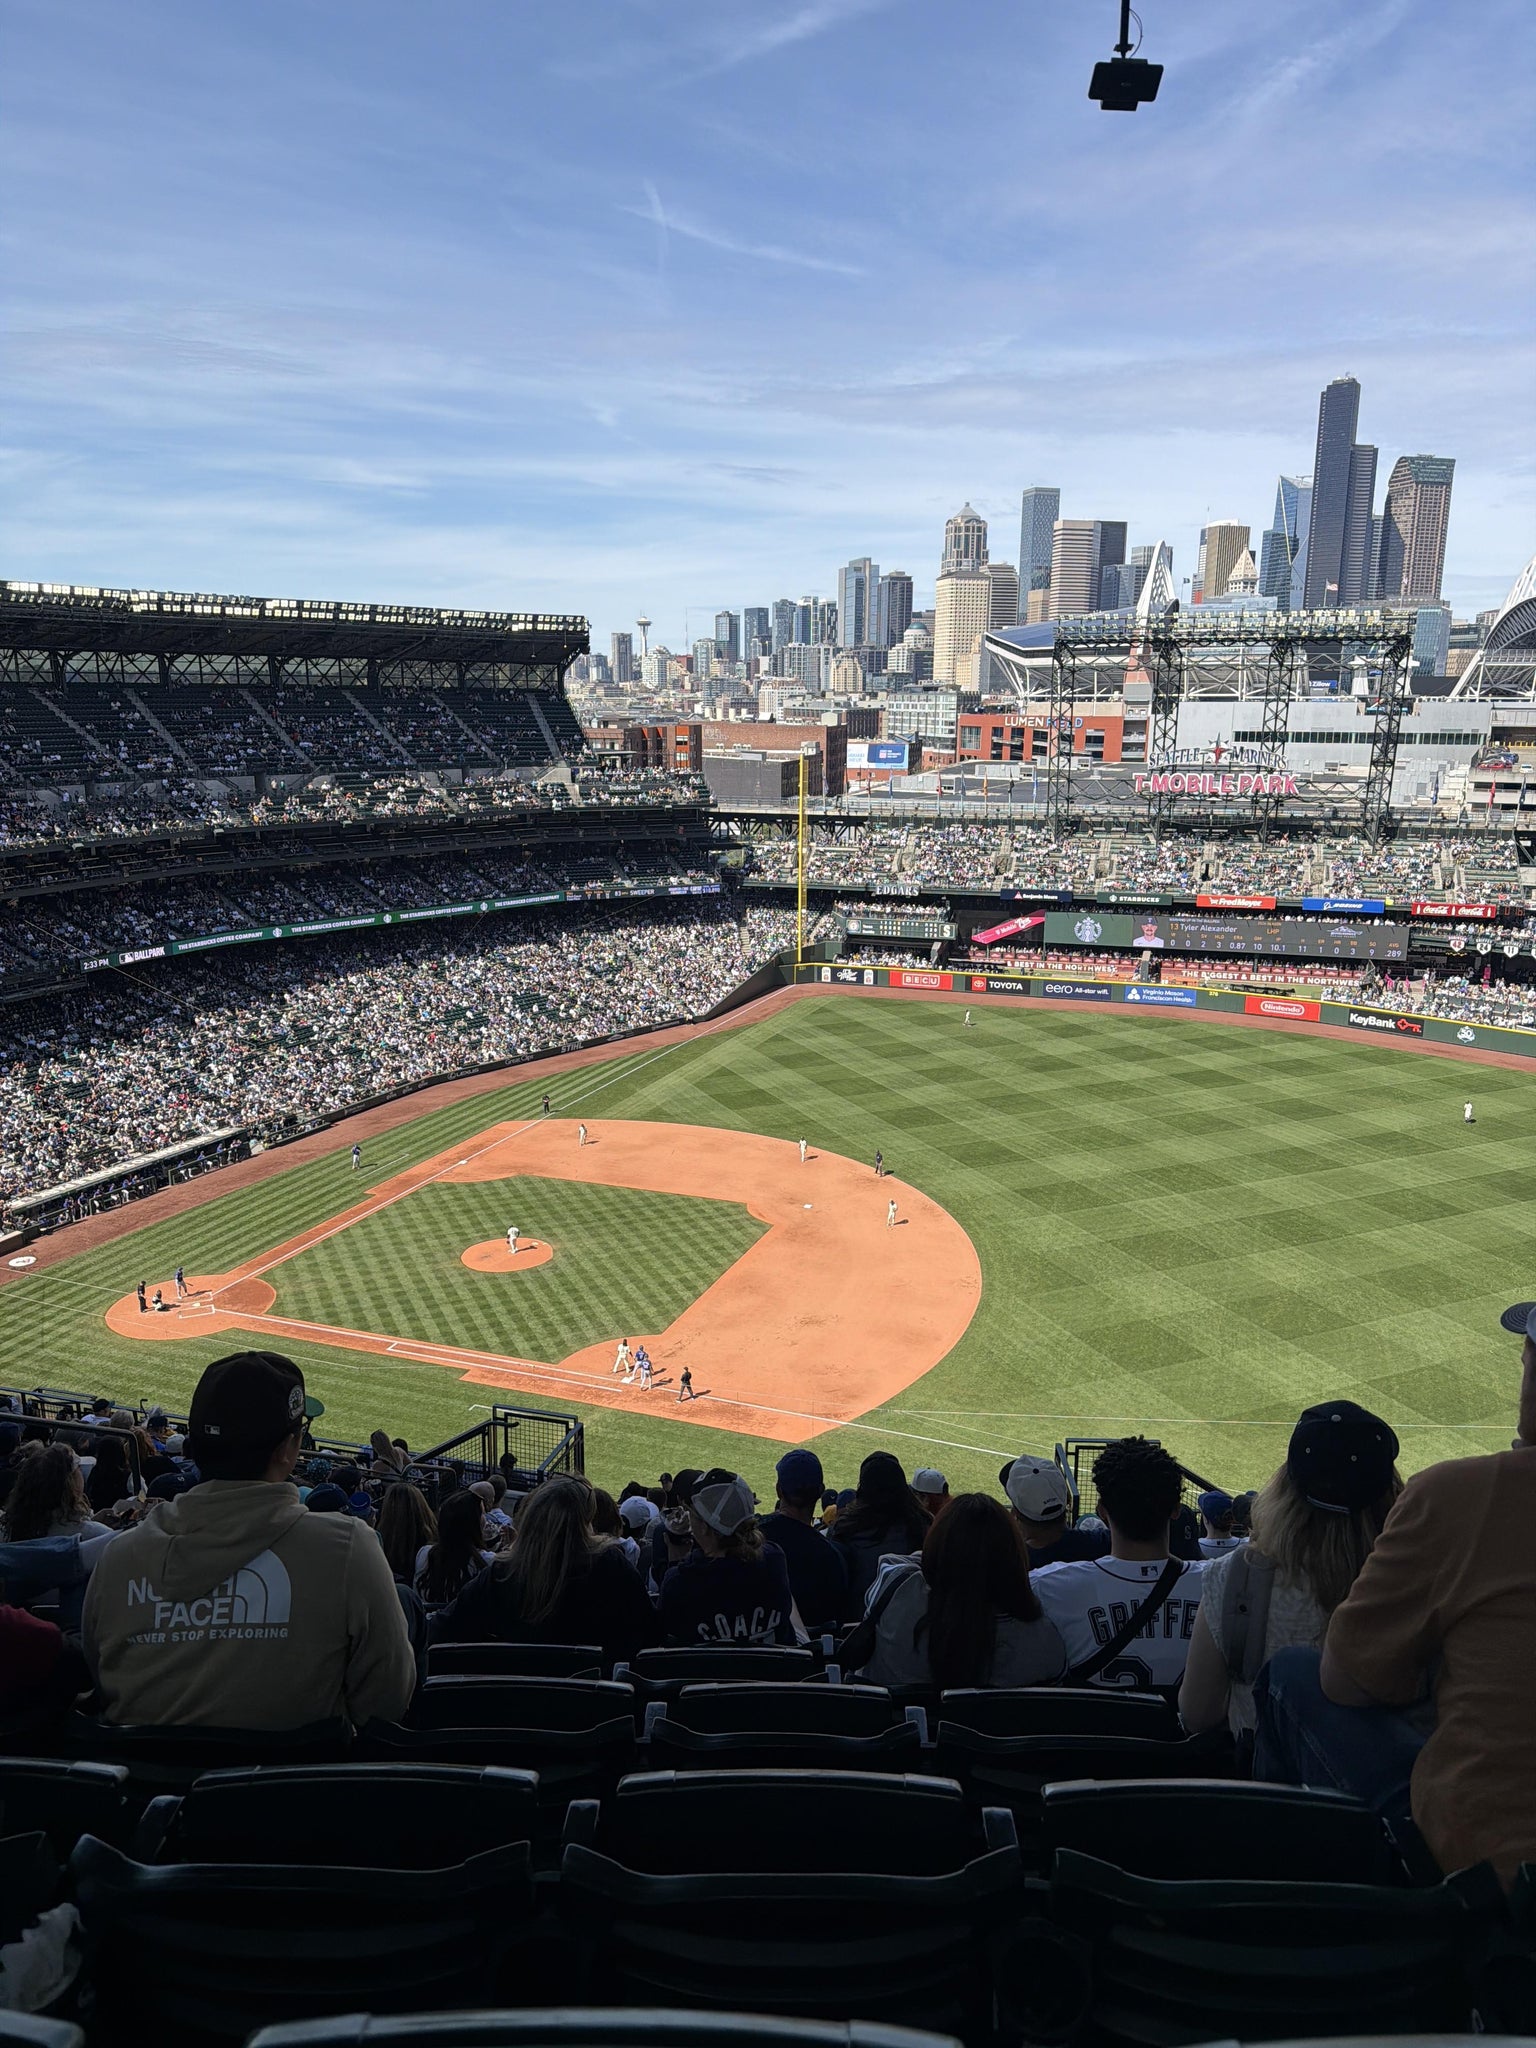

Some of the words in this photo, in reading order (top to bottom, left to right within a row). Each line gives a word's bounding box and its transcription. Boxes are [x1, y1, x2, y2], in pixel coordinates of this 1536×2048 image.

[1004, 716, 1044, 727] LUMEN
[1150, 748, 1200, 769] SEATTLE
[1232, 746, 1288, 770] MARINERS
[1133, 772, 1234, 795] T-MOBILE
[1238, 773, 1301, 796] PARK
[876, 885, 918, 896] EDGARS
[504, 898, 526, 906] STARBUCKS
[409, 910, 435, 918] STARBUCKS
[302, 923, 332, 932] STARBUCKS
[350, 917, 375, 926] COMPANY
[1180, 924, 1198, 932] Tyler
[1200, 924, 1238, 933] Alexander
[943, 925, 950, 937] S
[188, 938, 216, 949] STARBUCKS
[235, 931, 263, 941] COMPANY
[134, 946, 165, 961] BALLPARK
[83, 959, 98, 970] 2:33
[99, 958, 109, 967] PM
[905, 976, 937, 984] BECU
[989, 981, 1023, 990] TOYOTA
[1046, 983, 1072, 994] eero
[1264, 1003, 1301, 1013] Nintendo
[1350, 1013, 1396, 1029] KeyBank
[561, 1042, 584, 1053] STIHL
[154, 1597, 231, 1629] FACE
[697, 1606, 782, 1641] COACH
[172, 1630, 204, 1642] STOP
[209, 1627, 289, 1640] EXPLORING
